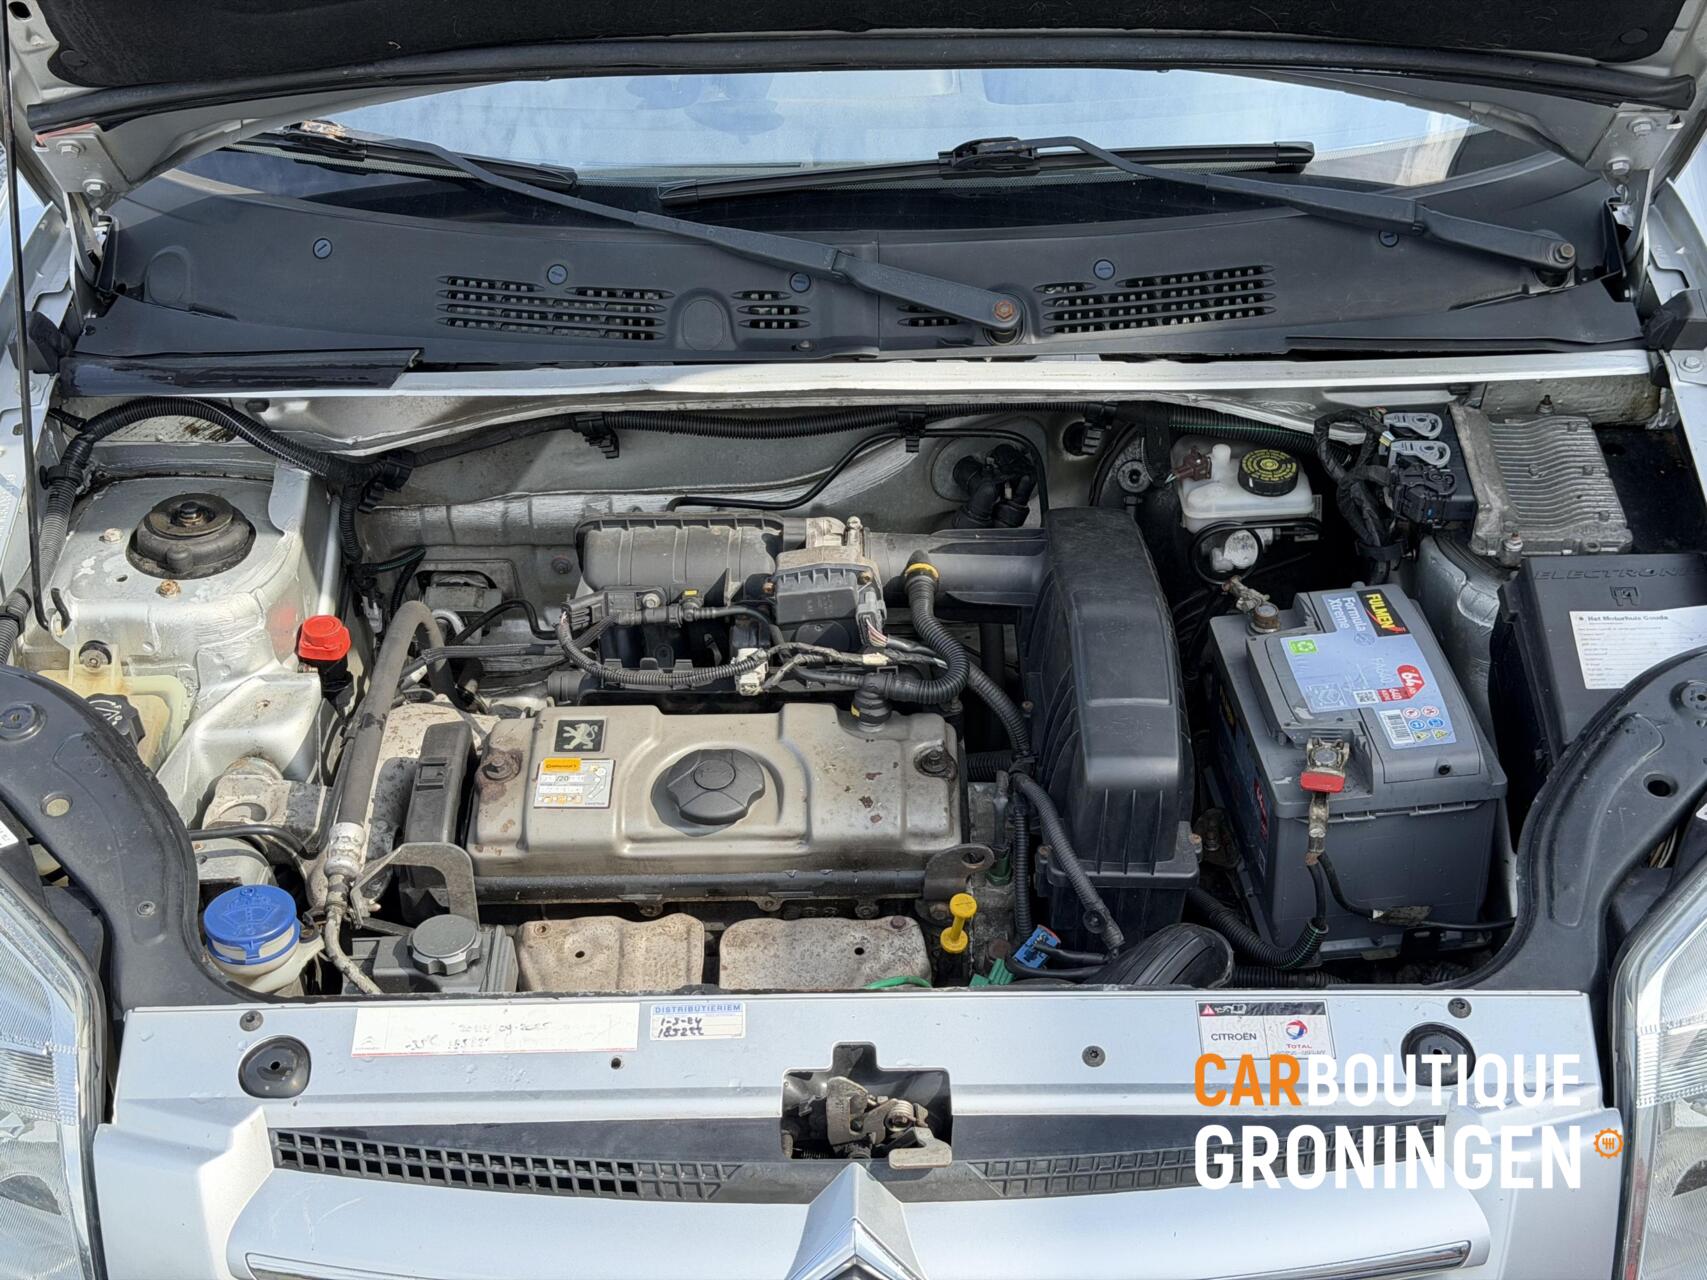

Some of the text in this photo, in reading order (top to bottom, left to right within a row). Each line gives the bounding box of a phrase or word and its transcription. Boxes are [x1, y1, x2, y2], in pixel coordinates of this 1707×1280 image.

[1535, 567, 1704, 580] ELECTRONI
[1327, 598, 1350, 629] Xtreme
[1342, 596, 1367, 632] Formula
[1366, 593, 1395, 629] FULMEN
[1401, 671, 1418, 688] 64
[654, 1003, 742, 1014] DISTRIBUTIERIEM
[1210, 1032, 1258, 1041] CITROËN
